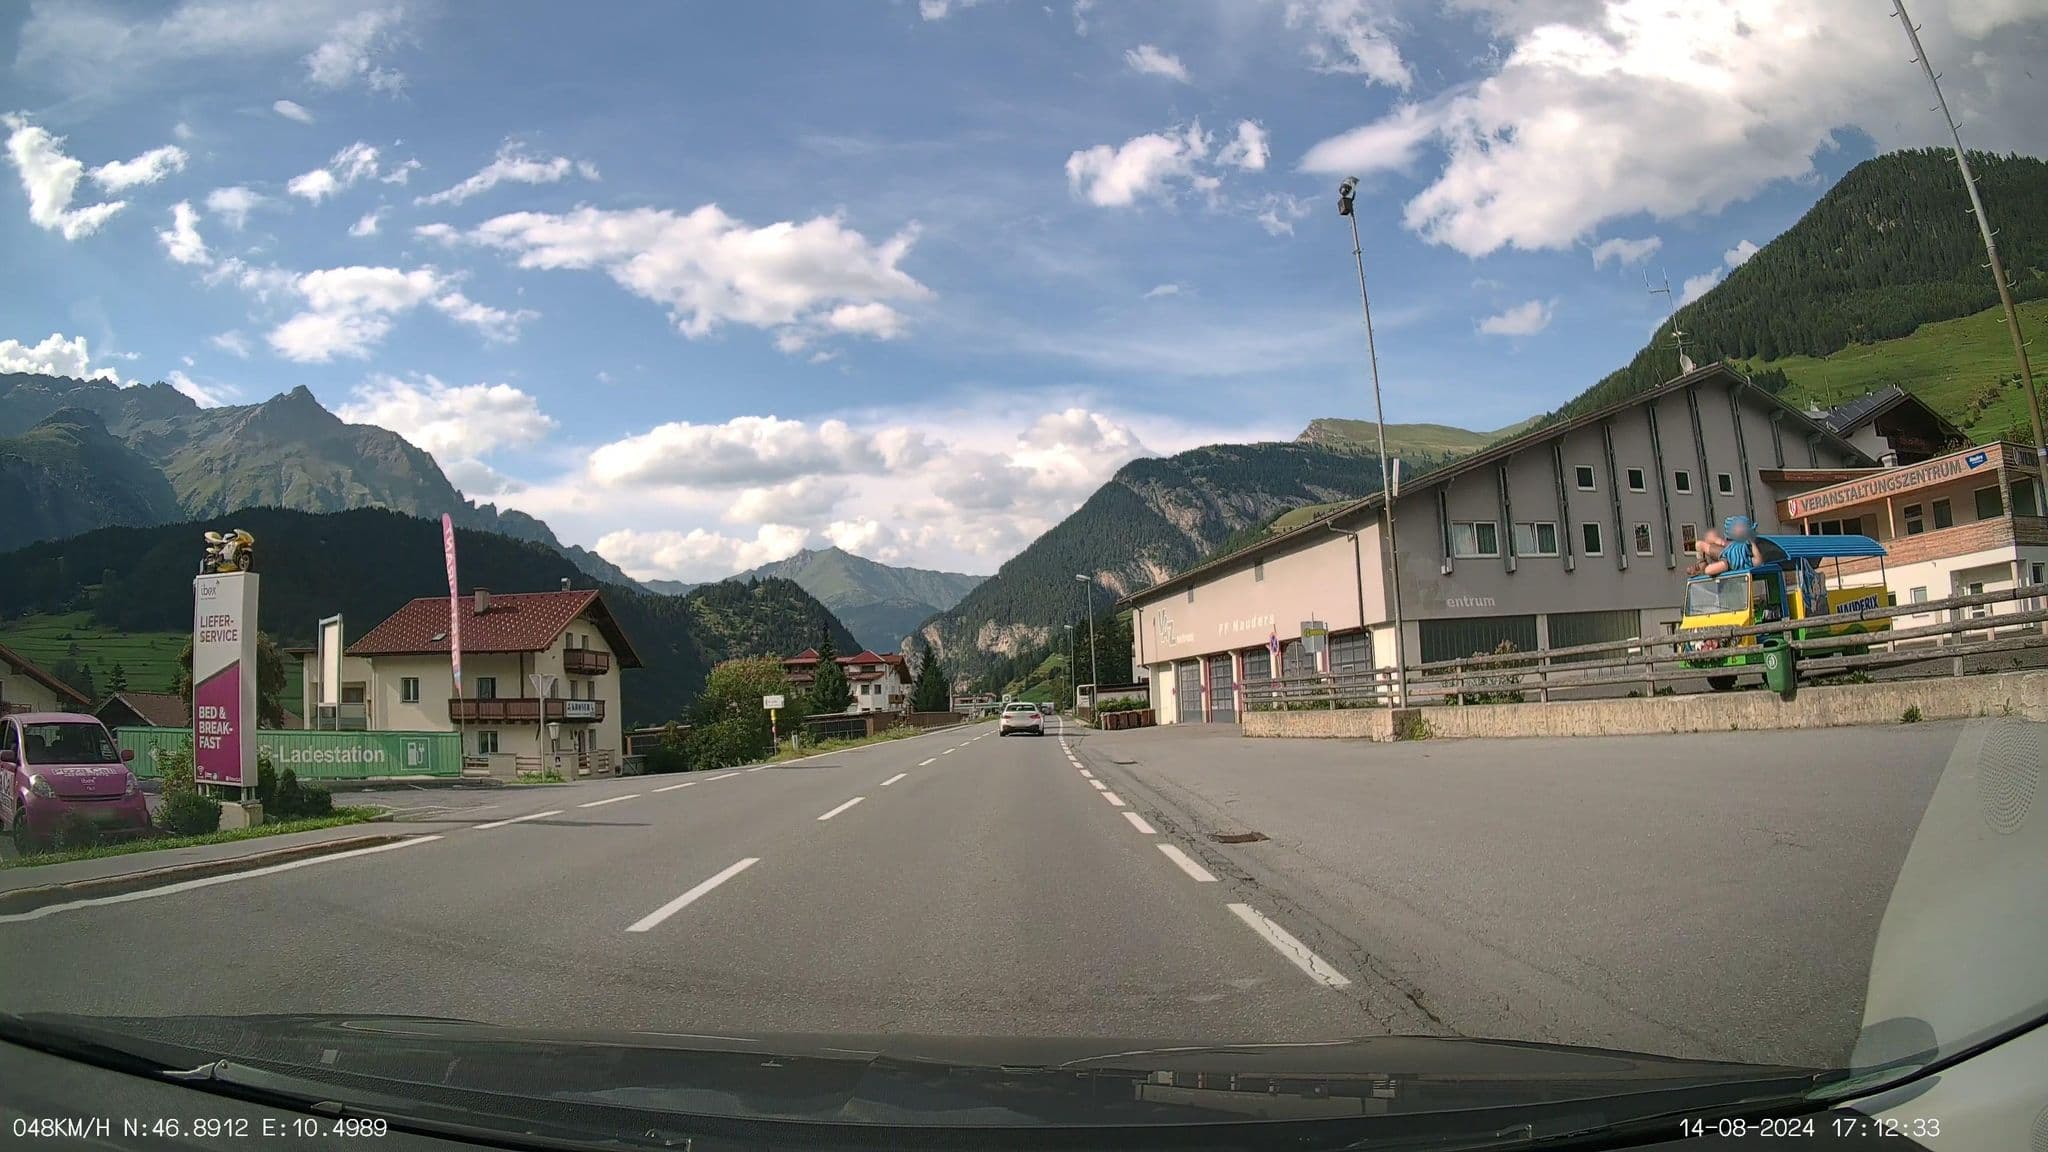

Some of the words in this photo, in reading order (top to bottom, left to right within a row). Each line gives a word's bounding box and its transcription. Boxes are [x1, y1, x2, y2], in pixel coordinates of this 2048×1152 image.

[1802, 459, 1962, 513] VERANSTALTUNGSZENTRUM
[1447, 596, 1496, 608] entrum
[200, 614, 235, 628] LIEFER-
[200, 629, 238, 643] SERVICE
[198, 705, 217, 719] BED
[218, 706, 227, 719] &
[199, 721, 234, 735] BREAK-
[199, 736, 222, 749] FAST
